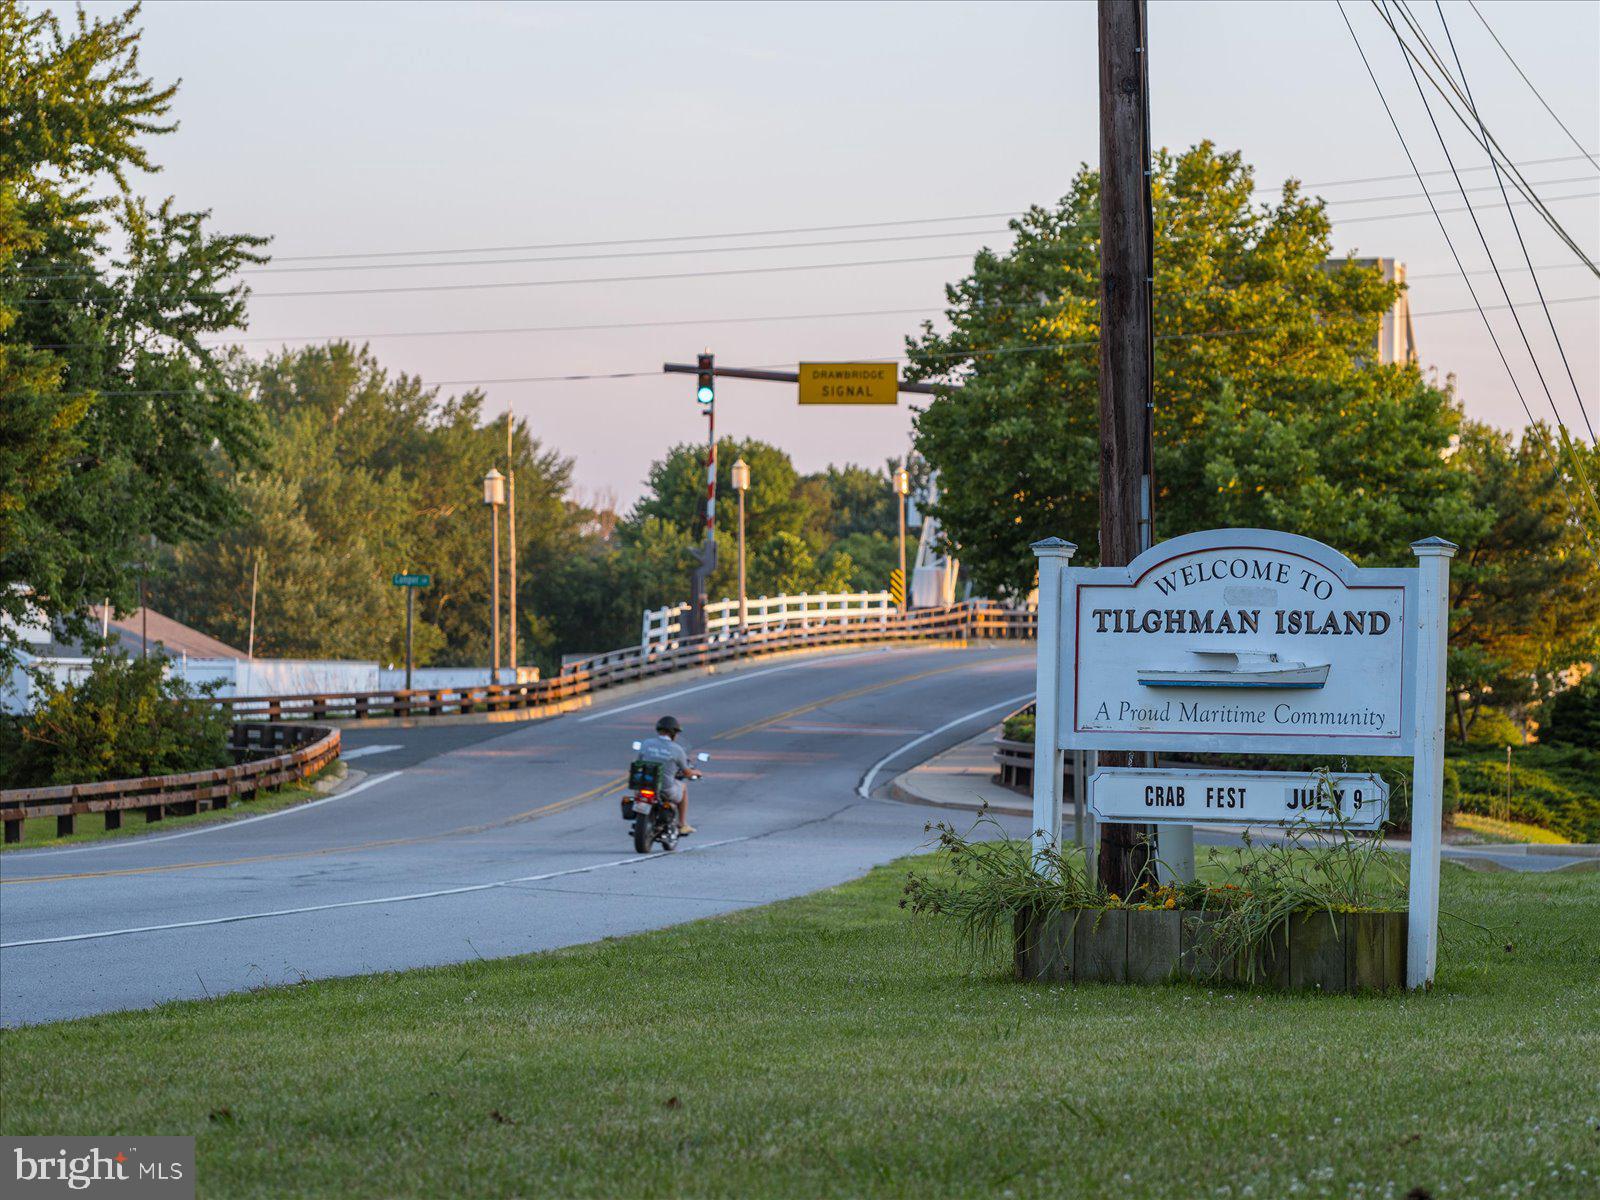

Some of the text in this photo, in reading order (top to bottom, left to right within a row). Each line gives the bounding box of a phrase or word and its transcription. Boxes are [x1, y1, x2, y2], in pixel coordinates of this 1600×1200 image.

[812, 370, 885, 380] DRAWBRIDGE
[822, 385, 874, 397] SIGNAL
[1153, 558, 1333, 601] WELCOME TO
[1092, 609, 1391, 635] TILGHMAN ISLAND
[1095, 701, 1386, 730] A Proud Maritime Community
[1144, 785, 1363, 811] CRAB FEST JULY 9
